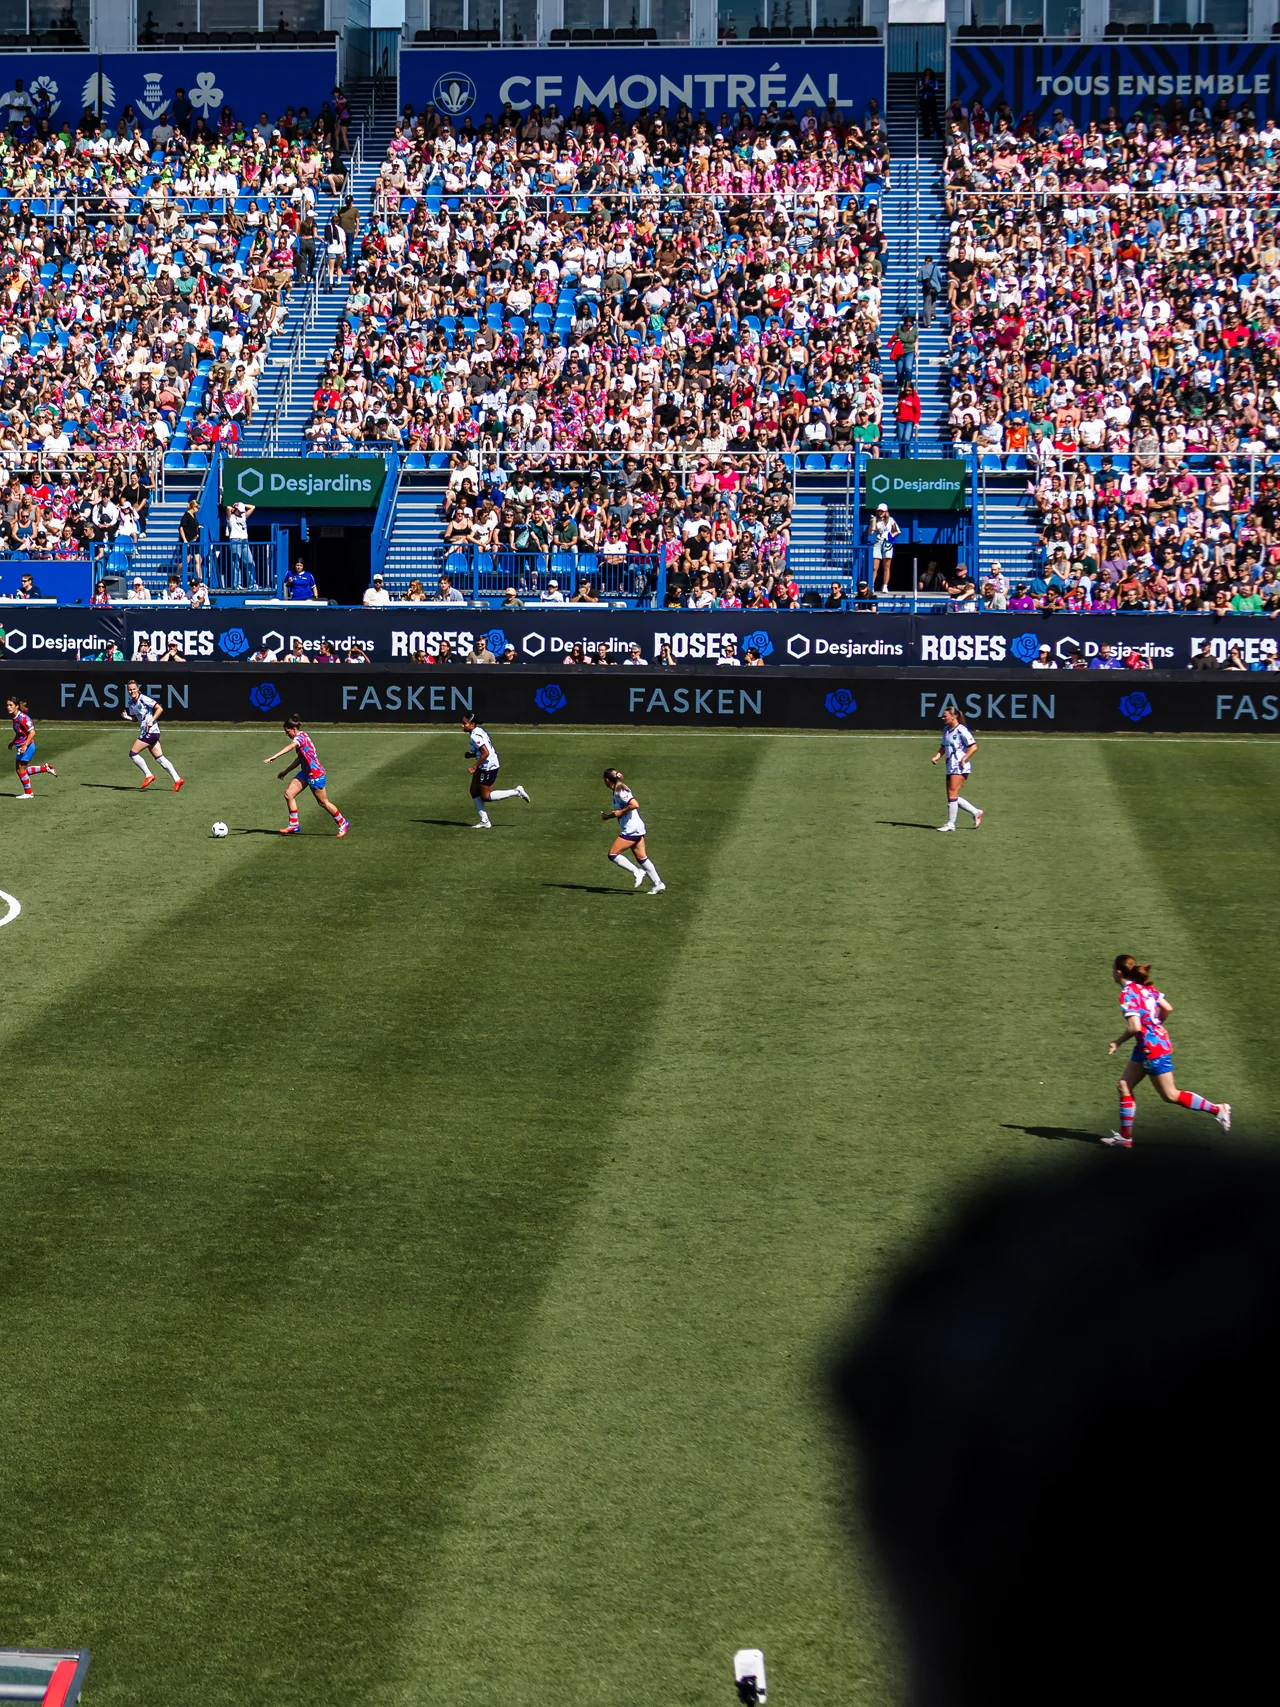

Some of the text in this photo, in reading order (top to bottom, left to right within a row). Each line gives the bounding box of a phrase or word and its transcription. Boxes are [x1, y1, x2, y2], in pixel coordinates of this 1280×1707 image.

[499, 62, 853, 110] CF MONTRÉAL
[1036, 74, 1270, 96] TOUS ENSEMBLE
[270, 473, 371, 496] Desjardins
[893, 478, 960, 493] Desjardins
[391, 631, 474, 657] ROSES
[816, 638, 903, 658] Desjardins
[921, 634, 1006, 661] ROSES
[342, 685, 473, 711] FASKEN
[629, 687, 762, 715] FASKEN
[921, 692, 1055, 719] FASKEN
